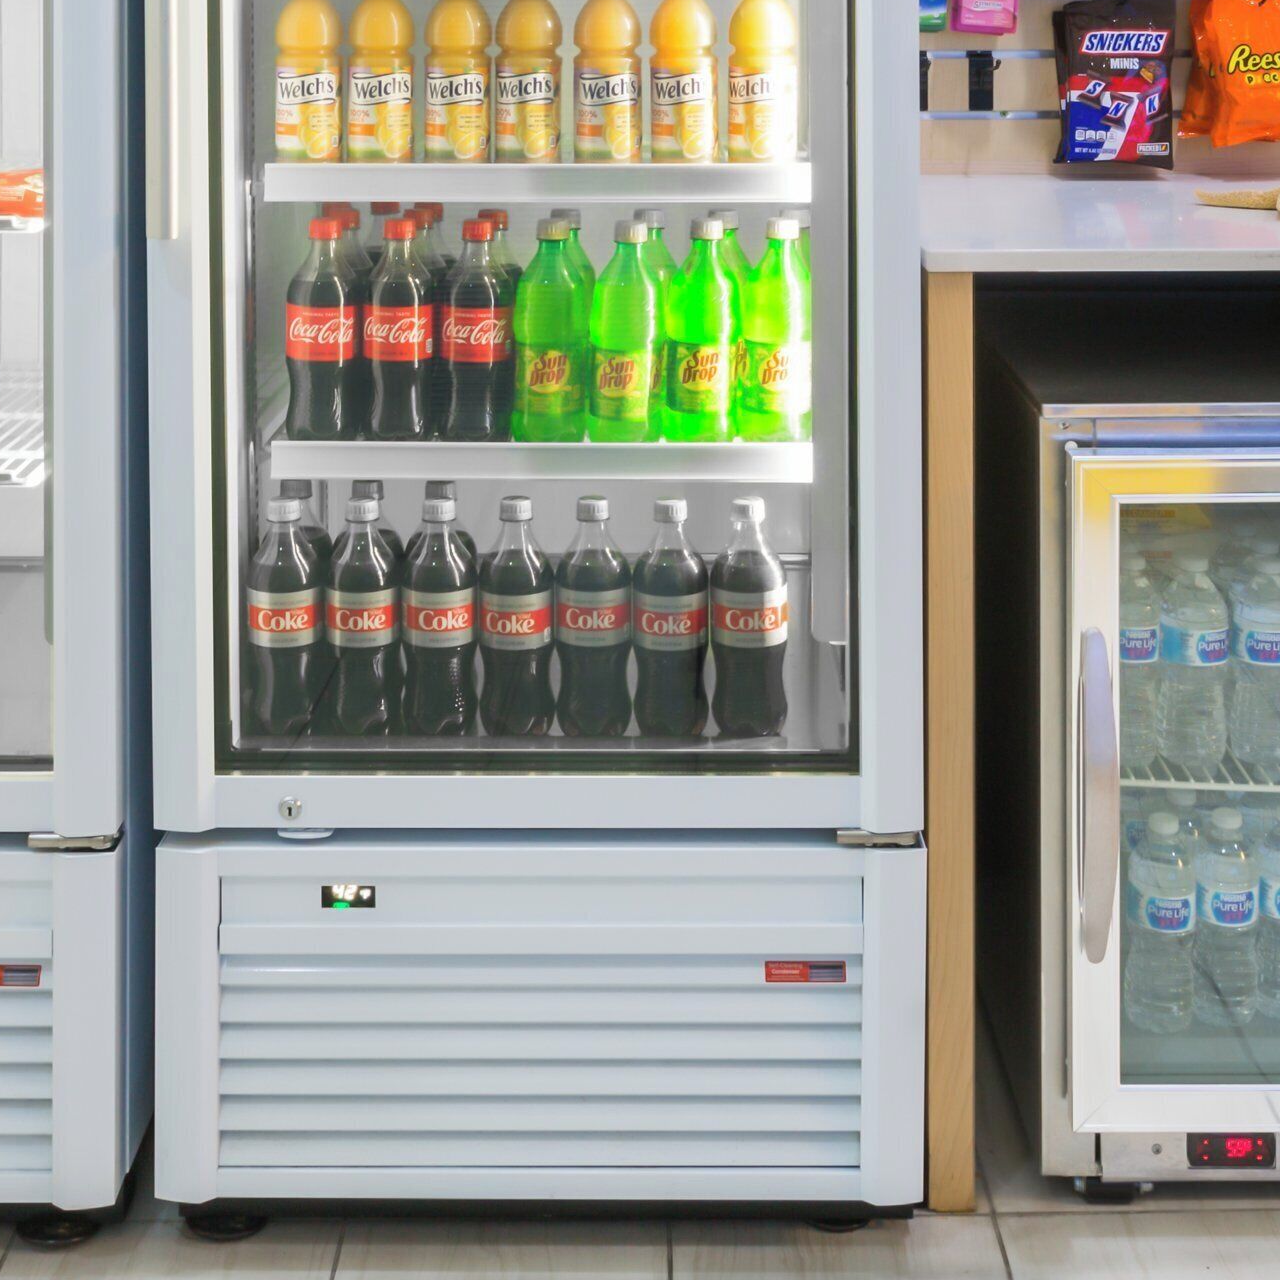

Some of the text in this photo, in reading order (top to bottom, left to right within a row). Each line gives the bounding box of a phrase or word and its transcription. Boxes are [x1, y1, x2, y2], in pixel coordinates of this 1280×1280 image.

[1084, 32, 1166, 53] SNICKERS
[280, 77, 334, 99] Welch's
[354, 77, 410, 99] Welch's
[429, 77, 482, 99] Welch's
[497, 77, 552, 99] Welch's
[582, 77, 637, 100] Welch's
[290, 317, 354, 345] Coca-Cola
[364, 317, 427, 345] Coca-Cola
[443, 317, 507, 345] Coca-Cola
[538, 352, 567, 370] Sun
[607, 357, 634, 375] Sun
[687, 351, 719, 370] Sun
[530, 367, 566, 387] Drop
[600, 371, 633, 391] Drop
[682, 366, 717, 386] Drop
[257, 609, 309, 631] Coke
[335, 609, 386, 631] Coke
[419, 609, 469, 631] Coke
[486, 610, 535, 634] Coke
[565, 608, 616, 630] Coke
[641, 612, 692, 635] Coke
[725, 610, 776, 631] Coke
